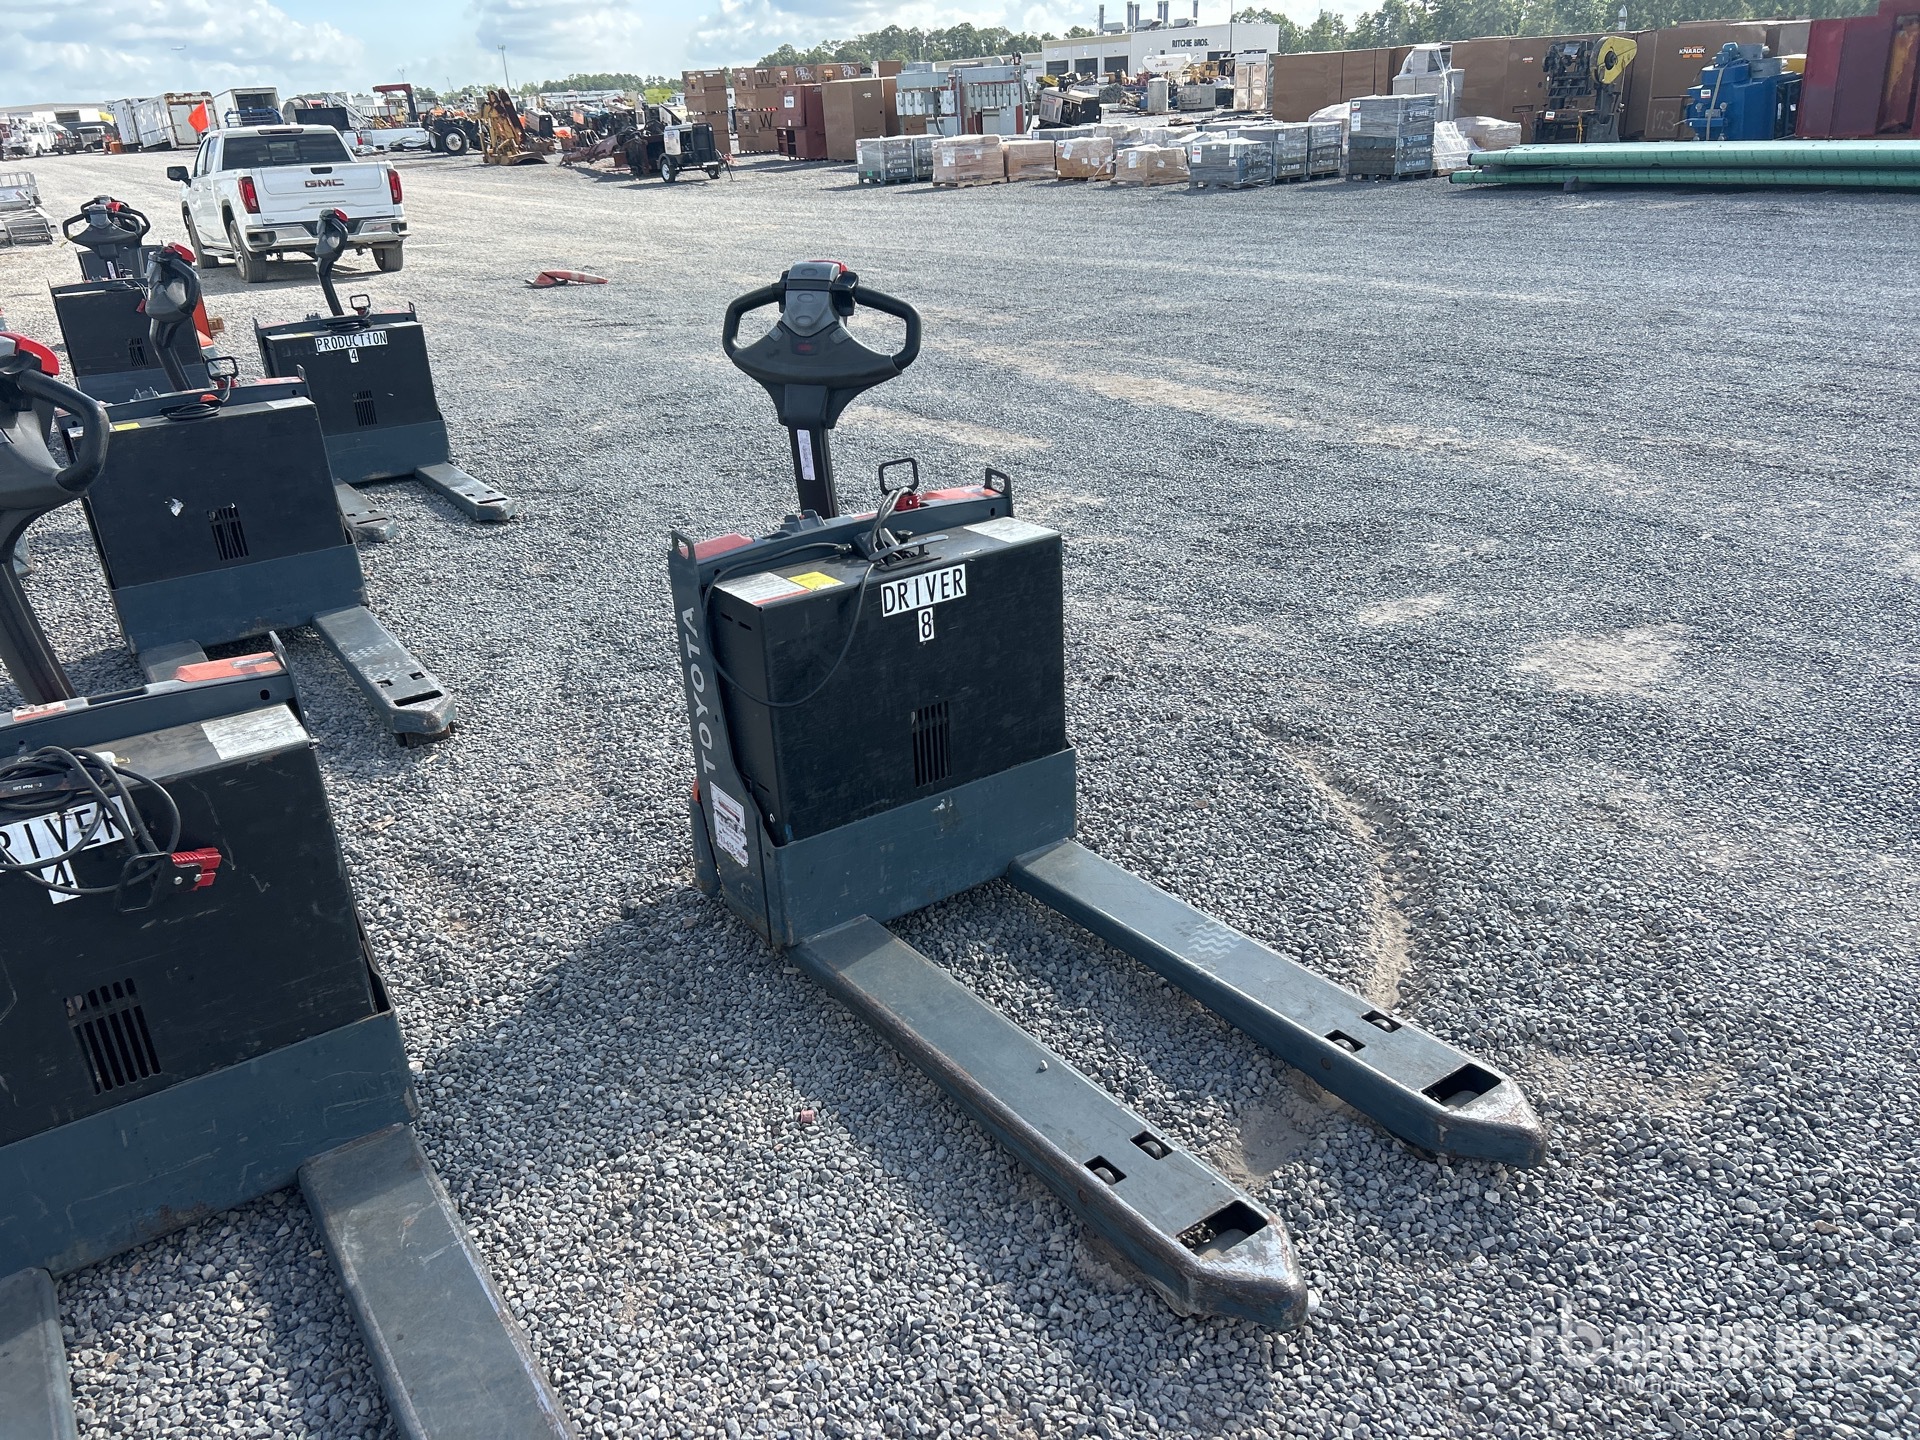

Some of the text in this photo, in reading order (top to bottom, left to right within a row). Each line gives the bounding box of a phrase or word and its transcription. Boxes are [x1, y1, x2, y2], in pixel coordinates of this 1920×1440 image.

[1172, 39, 1193, 48] RITCHIE
[1678, 47, 1706, 55] KNAACK
[304, 178, 345, 188] GMC
[316, 332, 387, 351] PRODUCTION
[350, 350, 358, 362] 4
[882, 568, 964, 614] DRIVER
[921, 610, 932, 638] 8
[682, 606, 716, 774] TOYOTA
